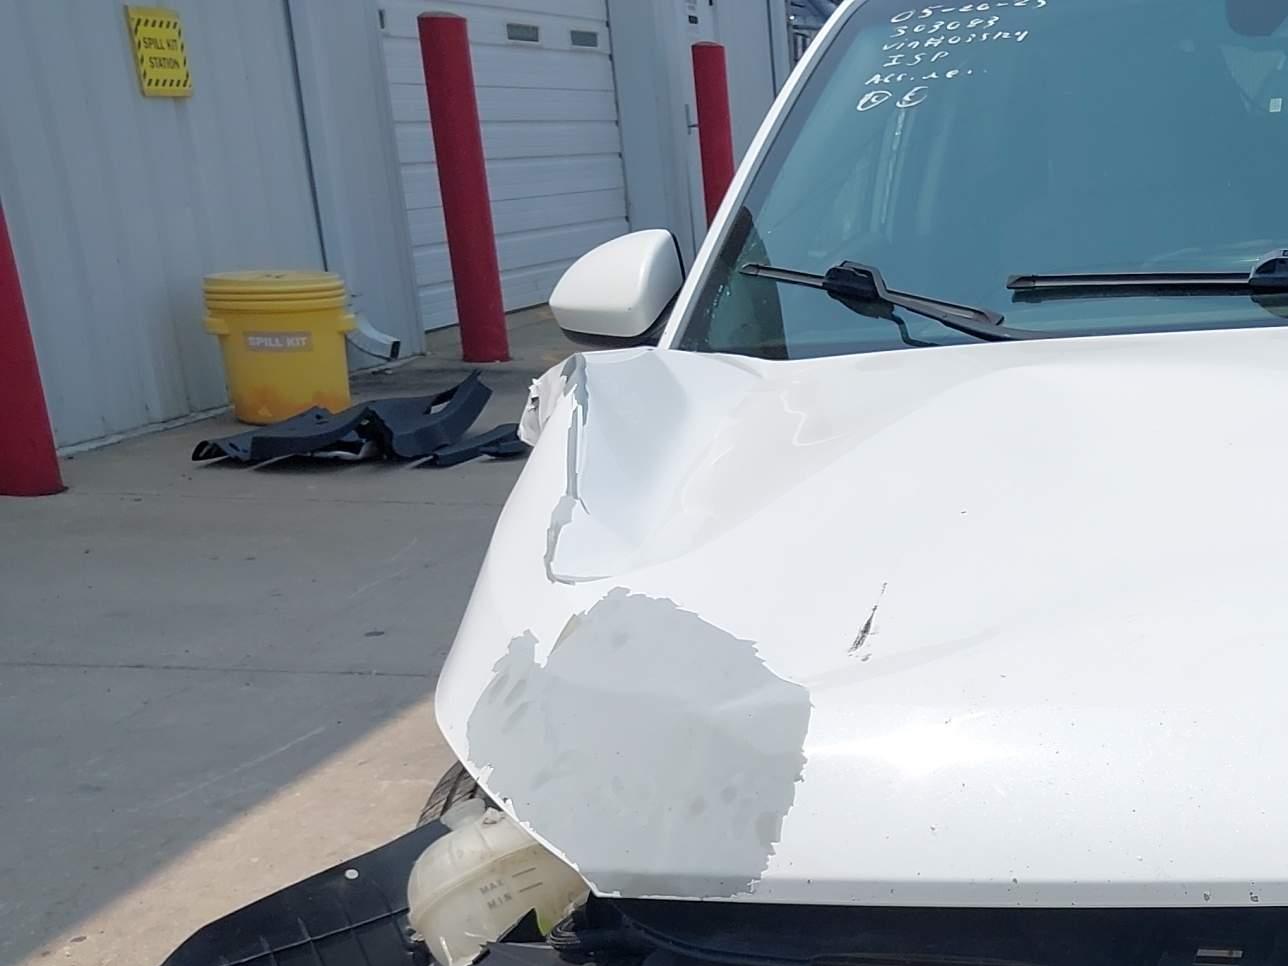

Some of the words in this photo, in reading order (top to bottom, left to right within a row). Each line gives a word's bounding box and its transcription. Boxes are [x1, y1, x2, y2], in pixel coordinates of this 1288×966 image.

[143, 37, 165, 50] SPILL
[166, 39, 178, 51] KIT
[149, 56, 180, 69] STATION
[248, 335, 283, 347] SPILL
[287, 335, 307, 347] KIT
[487, 894, 512, 910] MIN
